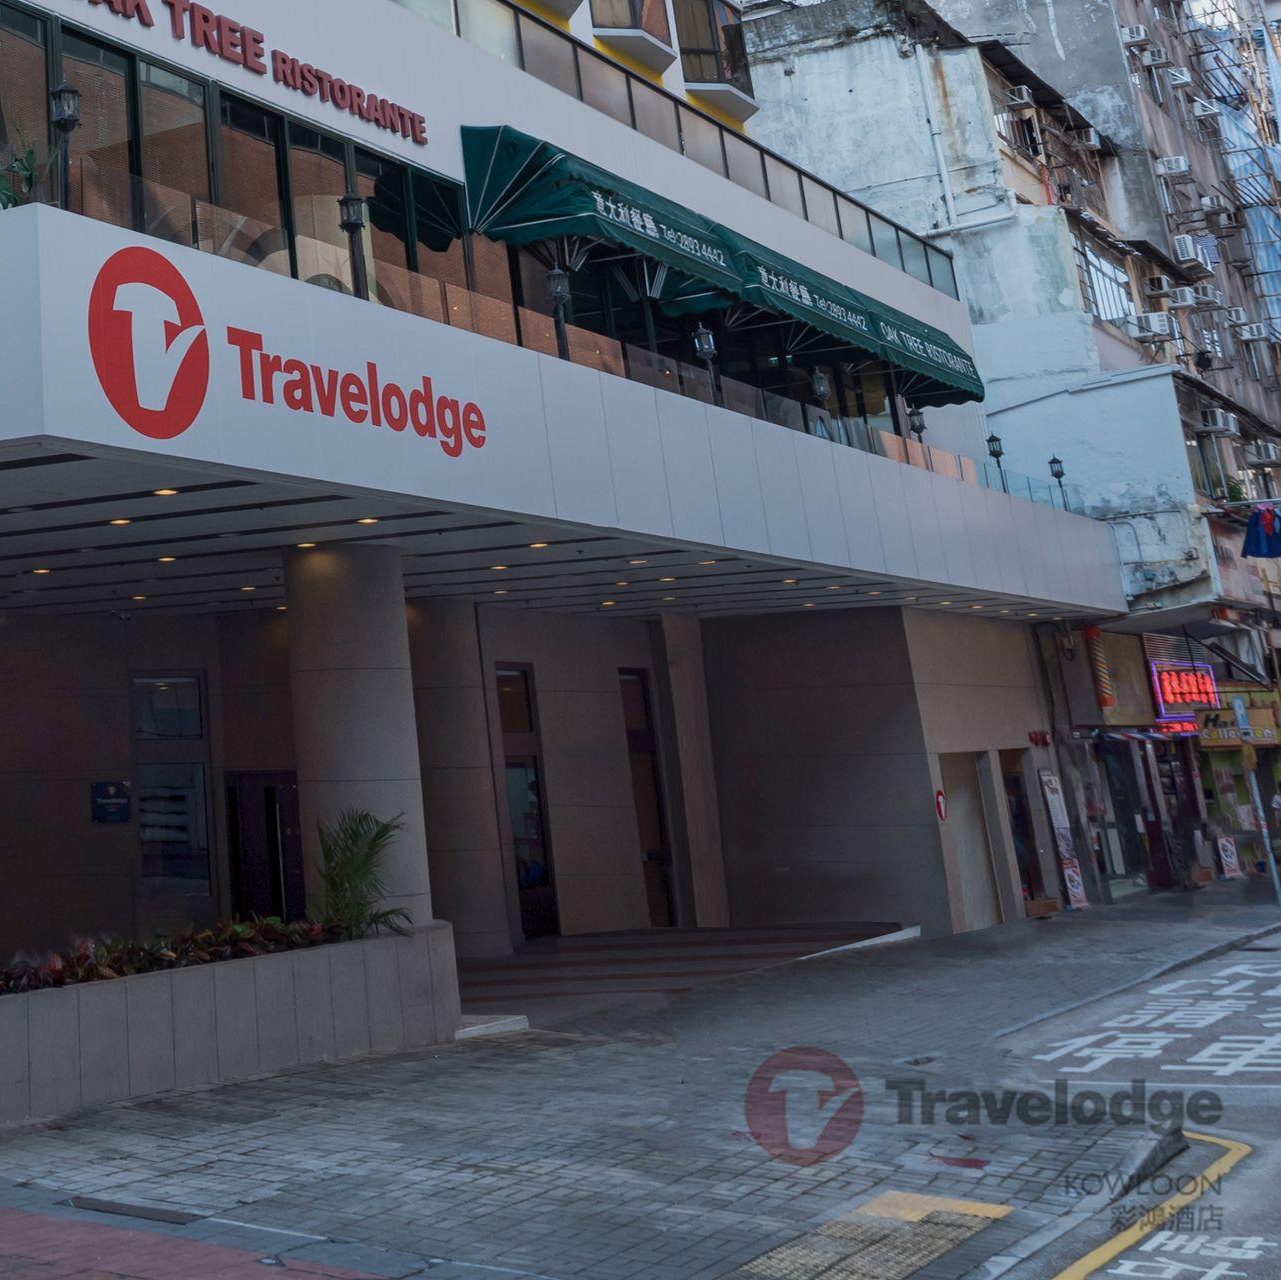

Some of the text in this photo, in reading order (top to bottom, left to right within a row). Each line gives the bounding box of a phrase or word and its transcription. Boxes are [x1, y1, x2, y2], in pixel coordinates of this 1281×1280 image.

[271, 49, 429, 146] RISTORANTE
[880, 321, 903, 347] OAK
[899, 330, 927, 357] TREE
[227, 327, 487, 458] Travelodge
